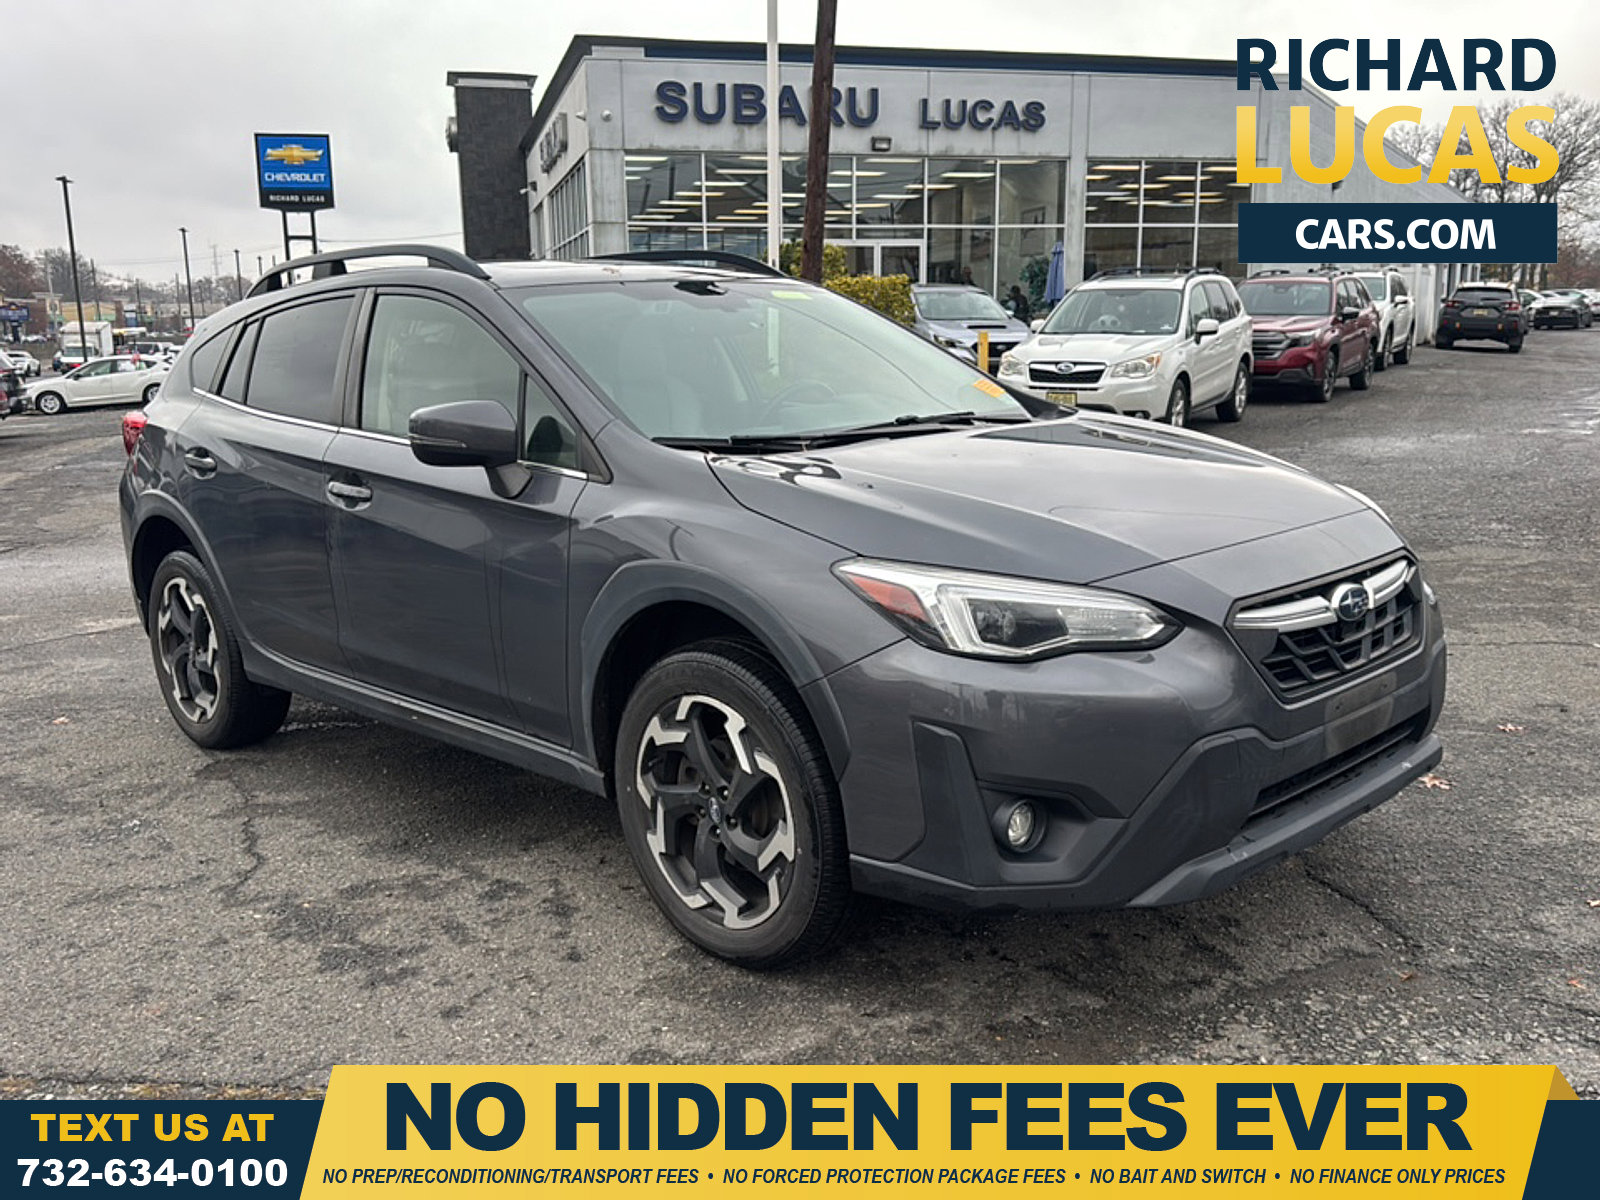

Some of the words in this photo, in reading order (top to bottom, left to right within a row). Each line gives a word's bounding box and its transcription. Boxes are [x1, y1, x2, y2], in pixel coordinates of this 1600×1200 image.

[920, 98, 1046, 132] LUCAS
[264, 172, 325, 183] CHEVROLET
[269, 194, 299, 202] RICHARD
[302, 194, 325, 203] LUCAS
